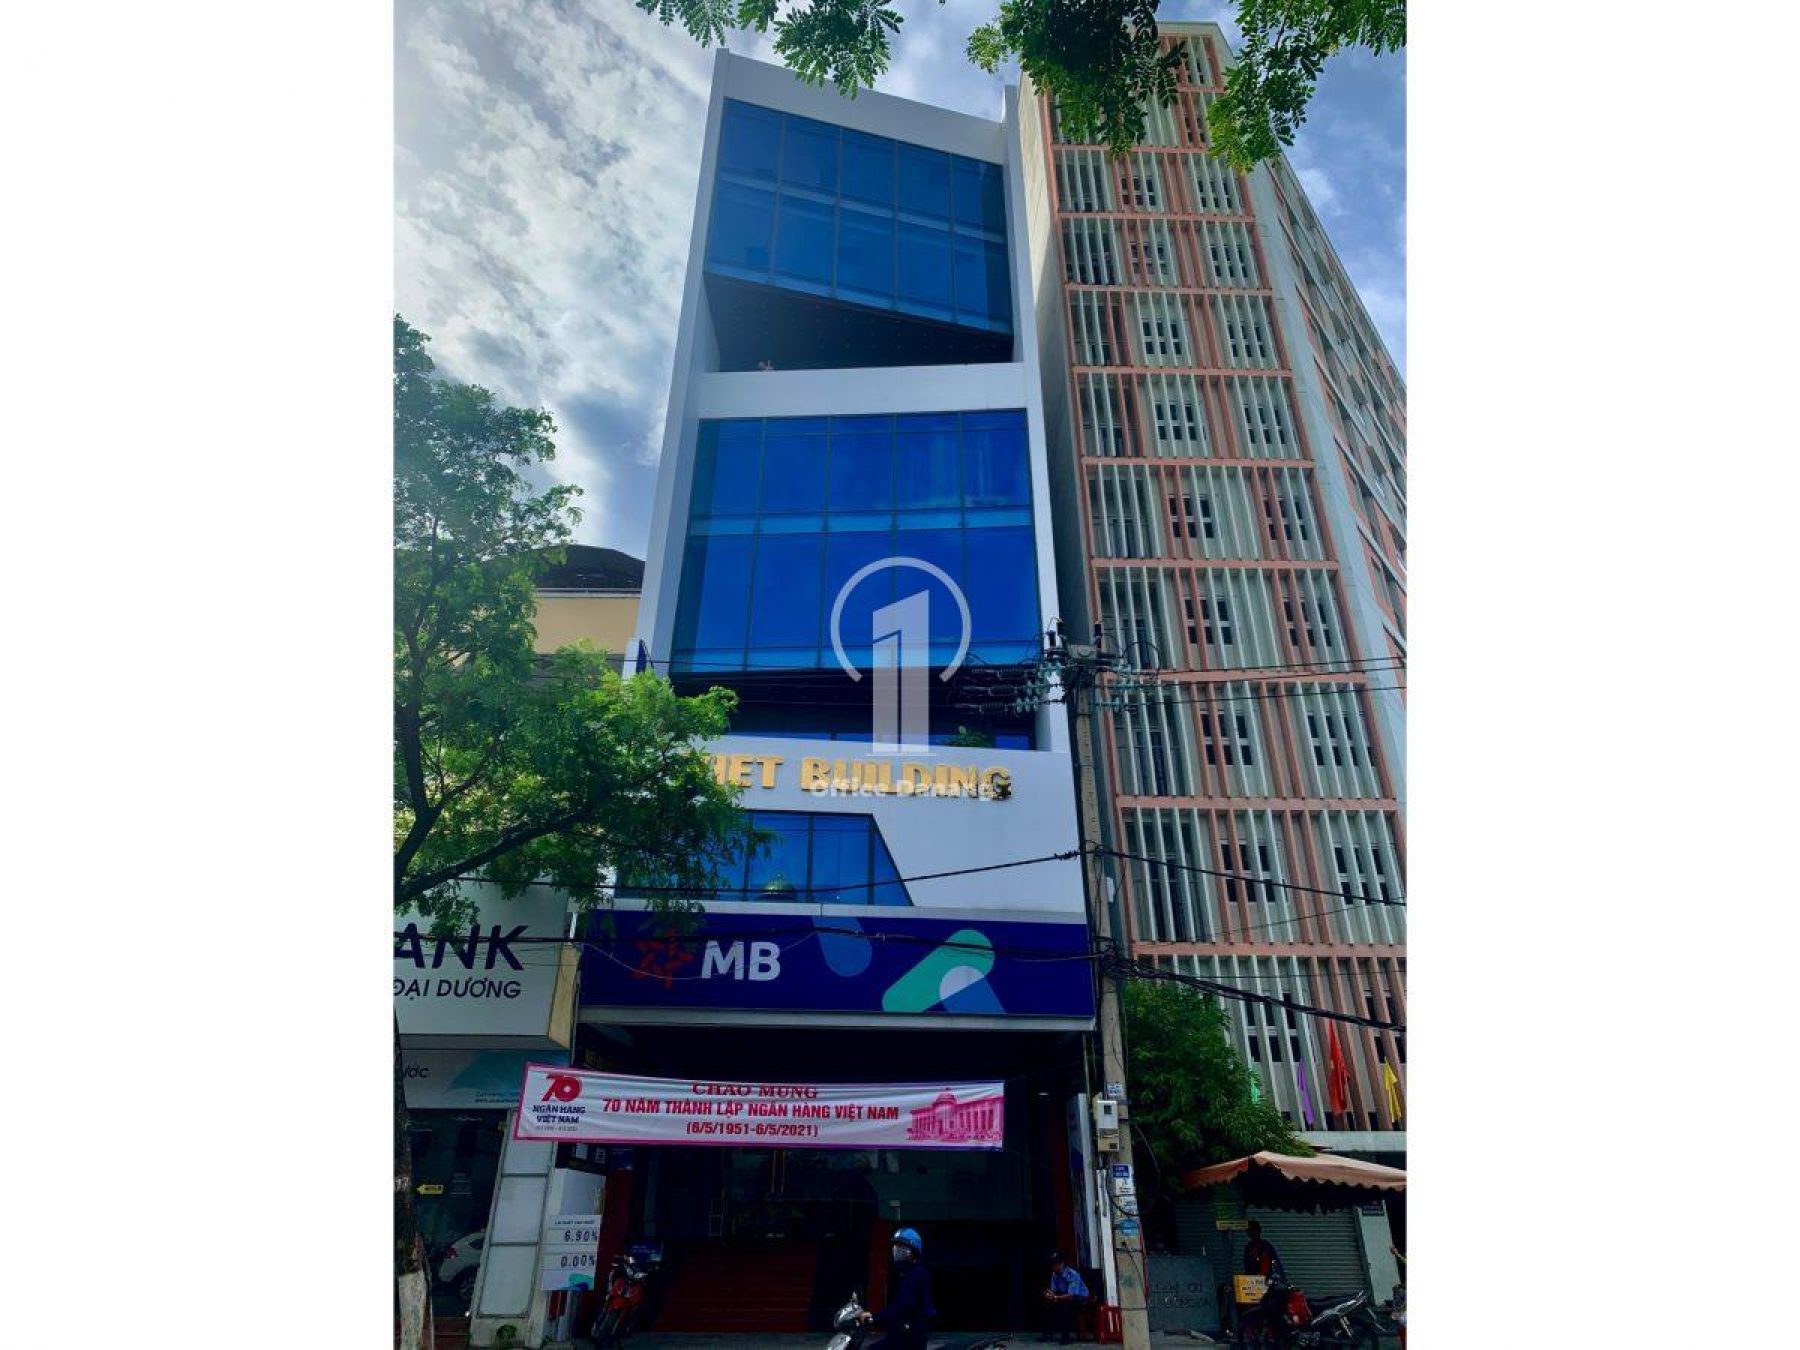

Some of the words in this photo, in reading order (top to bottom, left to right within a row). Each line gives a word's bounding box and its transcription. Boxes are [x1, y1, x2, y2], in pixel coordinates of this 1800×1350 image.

[701, 755, 784, 789] IET
[800, 756, 1012, 801] BUILDING
[393, 922, 529, 971] ANK
[702, 940, 781, 981] MB
[436, 977, 522, 999] DƯƠNG
[541, 1074, 582, 1103] 70
[603, 1098, 621, 1113] 70
[625, 1098, 660, 1114] NĂM
[716, 1100, 744, 1120] LẬP
[749, 1100, 788, 1117] NGÂN
[792, 1103, 830, 1120] HÀNG
[835, 1103, 863, 1123] VIỆT
[867, 1106, 899, 1120] NAM
